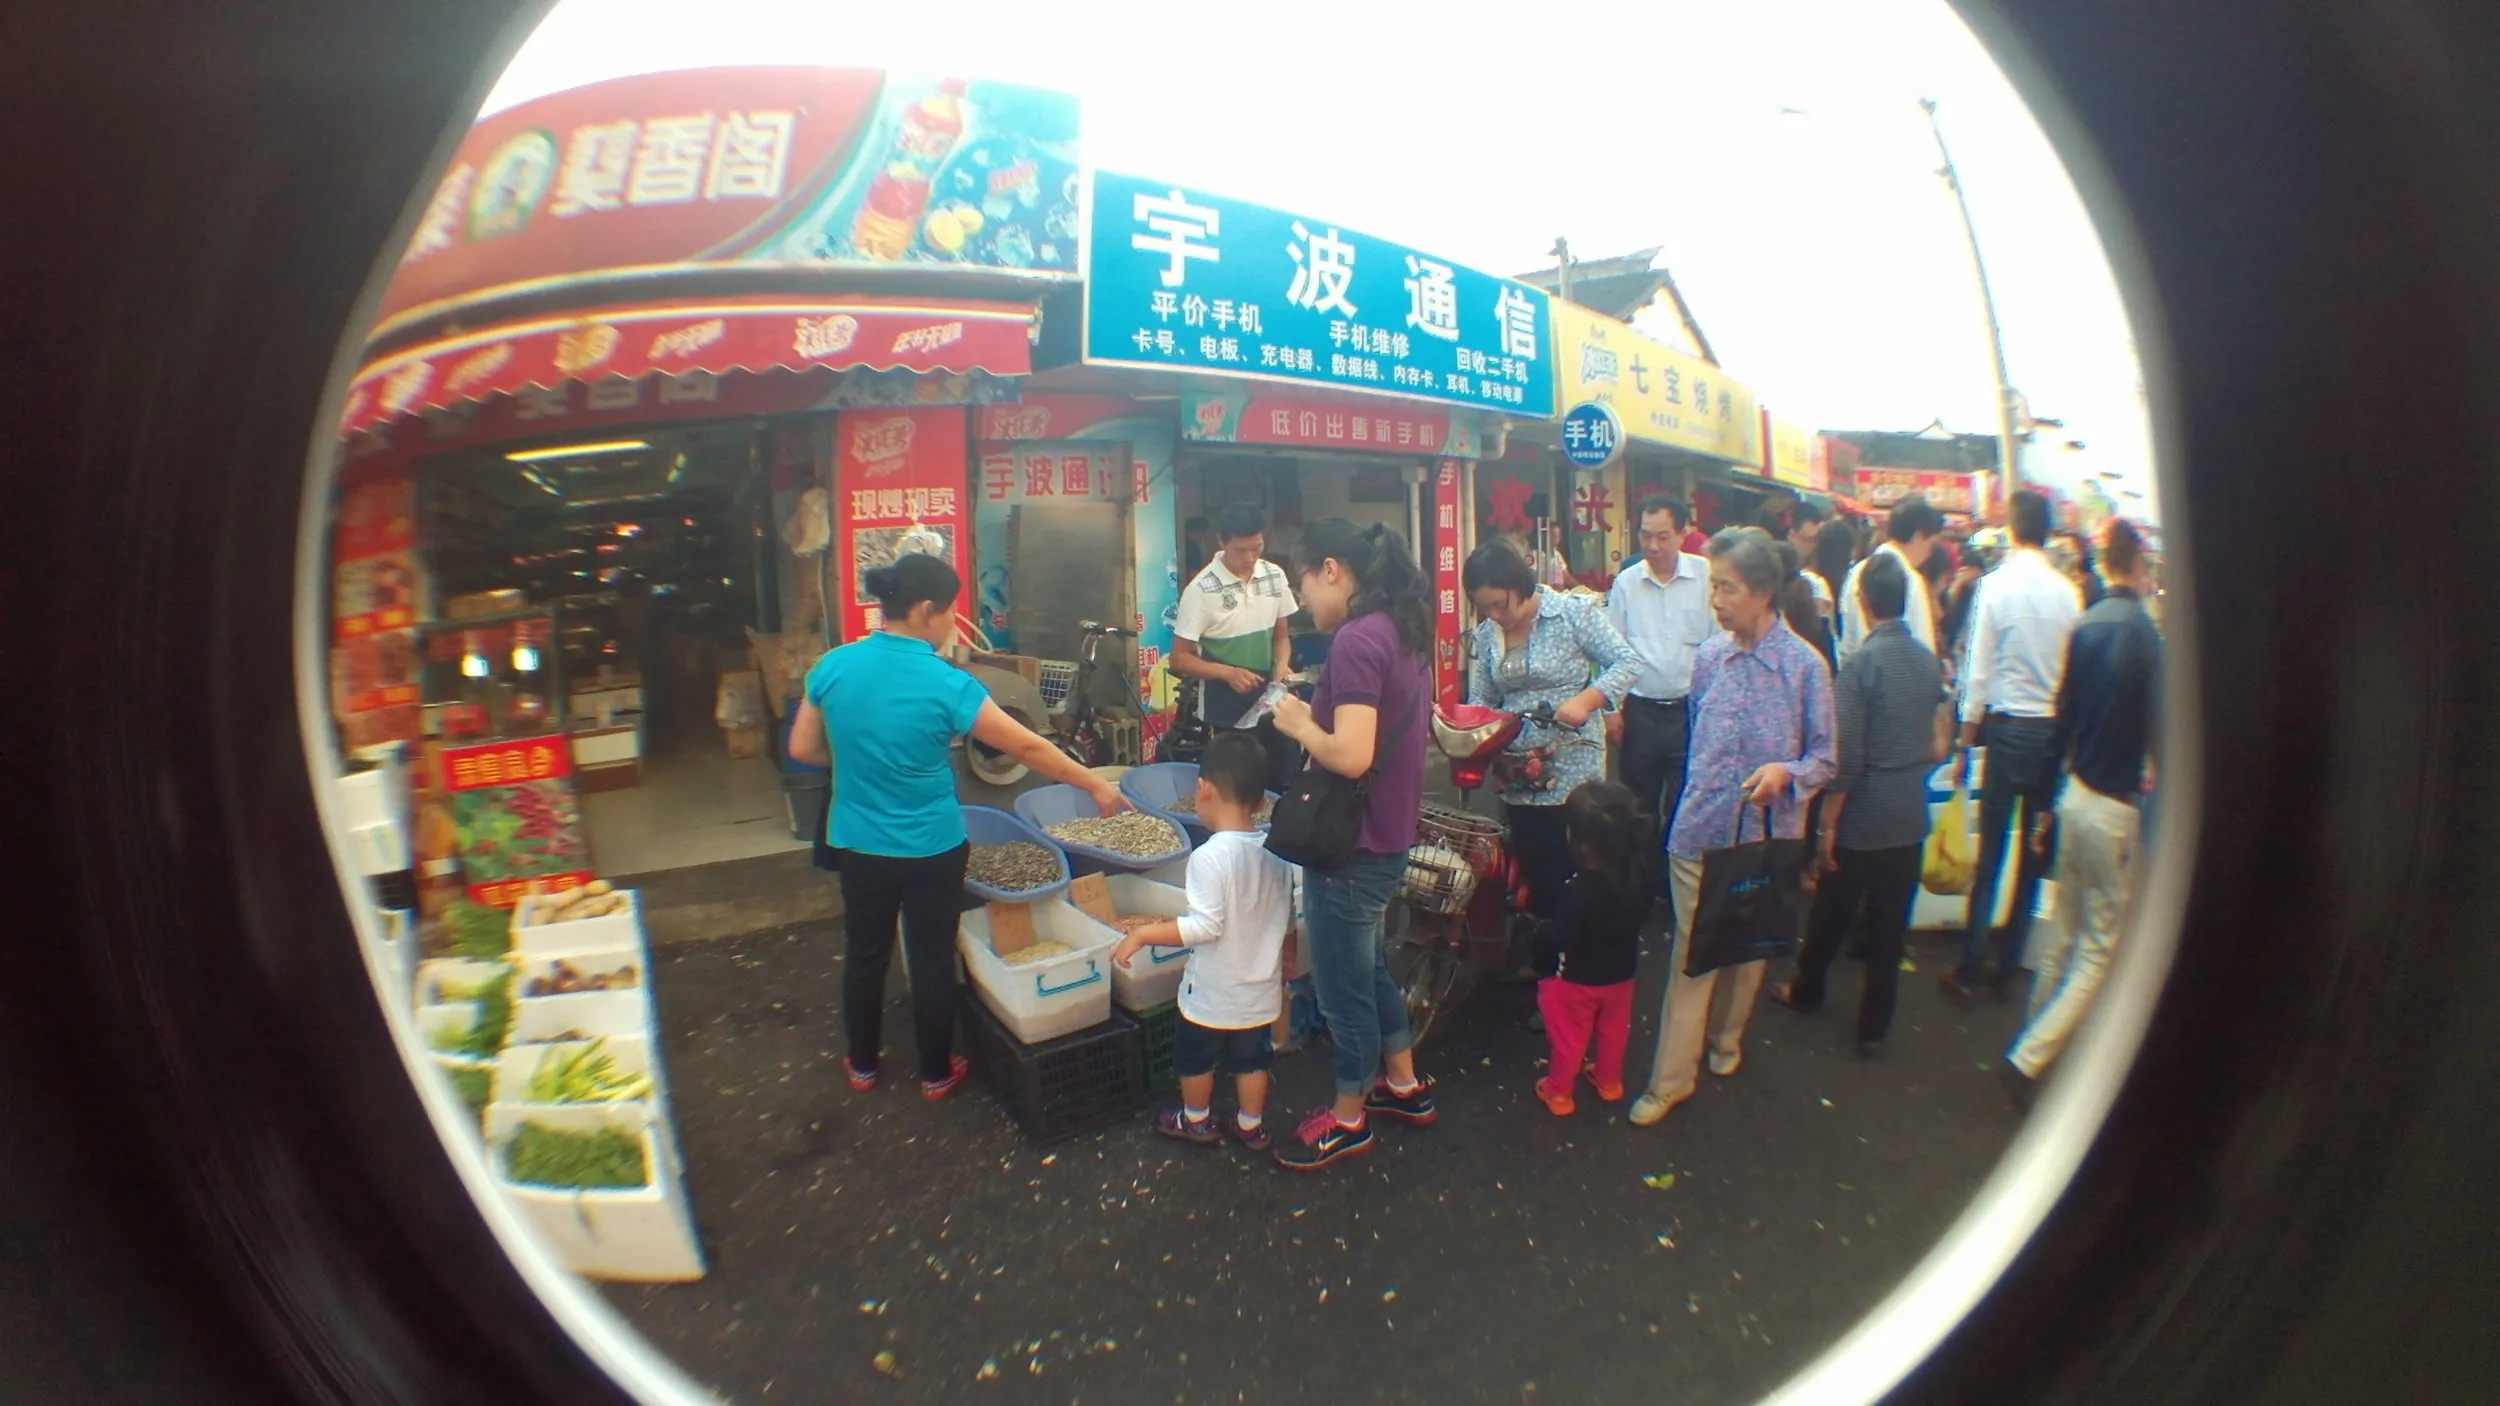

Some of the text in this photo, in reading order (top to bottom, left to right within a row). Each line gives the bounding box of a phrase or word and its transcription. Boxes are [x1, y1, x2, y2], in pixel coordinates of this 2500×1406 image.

[1131, 189, 1537, 361] 宇波通信
[1151, 290, 1263, 337] 平价手机
[1329, 320, 1410, 360] 手机维修
[1456, 347, 1529, 384] 回收二手机
[1271, 409, 1433, 447] 低价出售新手机
[1565, 420, 1613, 448] 手机
[1439, 462, 1455, 614] 手机维修
